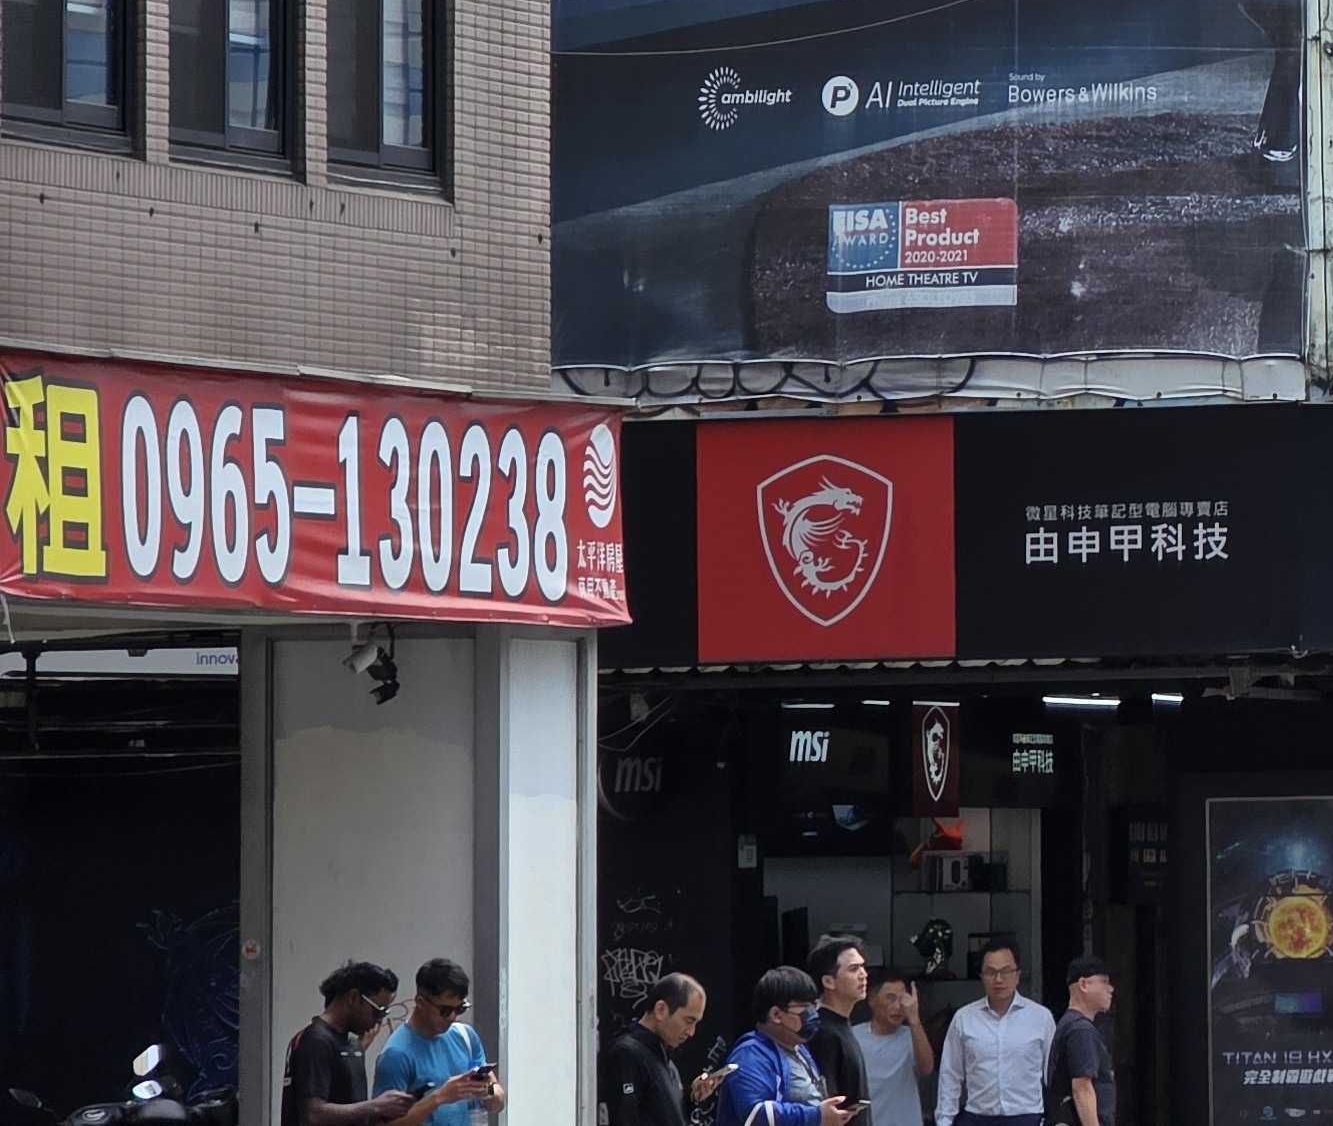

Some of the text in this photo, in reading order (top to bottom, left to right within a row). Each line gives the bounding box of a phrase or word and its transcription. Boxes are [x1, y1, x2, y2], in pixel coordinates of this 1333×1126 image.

[1009, 73, 1046, 82] Sound by
[721, 88, 792, 105] ambilight
[865, 81, 893, 109] AI
[898, 79, 981, 97] Intelligent
[1008, 82, 1158, 103] Bowers & Wilkins
[905, 207, 948, 225] Best
[904, 228, 980, 247] Product
[904, 249, 968, 264] 2020-2021
[866, 271, 979, 288] HOME THEATRE TV
[4, 374, 568, 600] 租 0965-130238
[1024, 521, 1230, 565] 由申甲科技
[790, 730, 829, 762] msi
[1012, 748, 1054, 774] 由申甲科技
[614, 758, 663, 793] msi
[1222, 1051, 1277, 1065] TITAN
[1307, 1049, 1333, 1064] HX
